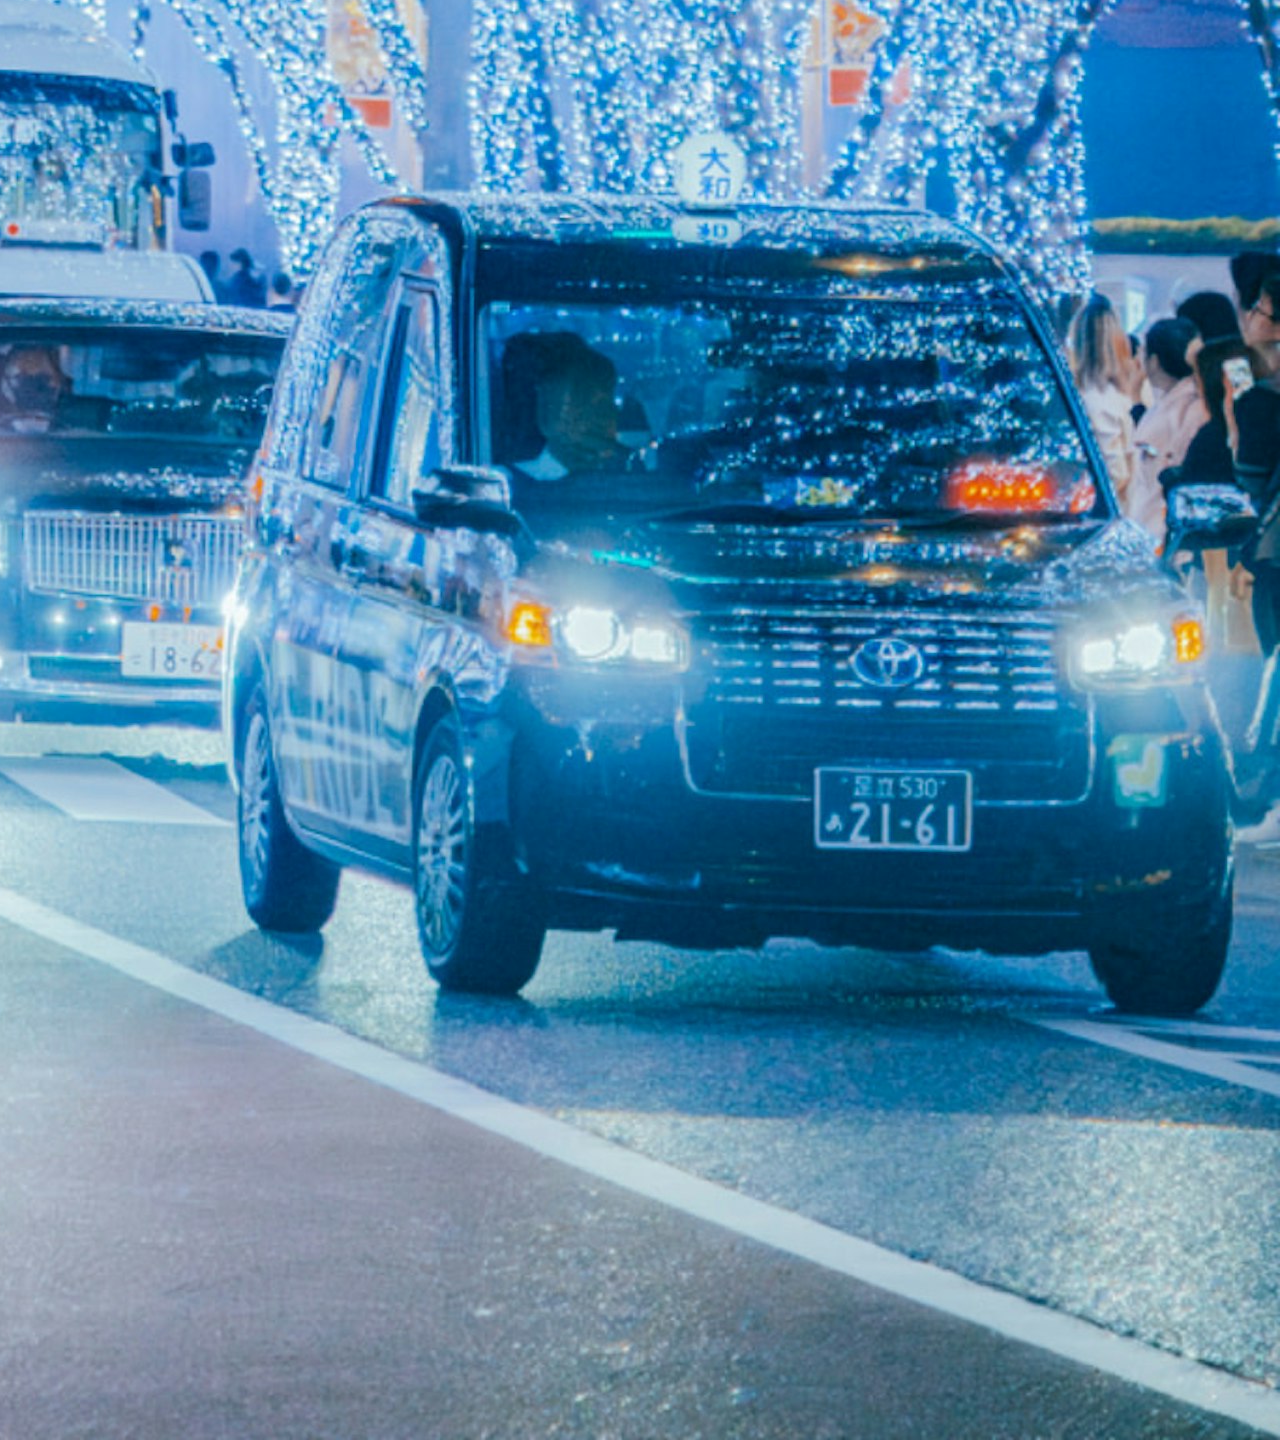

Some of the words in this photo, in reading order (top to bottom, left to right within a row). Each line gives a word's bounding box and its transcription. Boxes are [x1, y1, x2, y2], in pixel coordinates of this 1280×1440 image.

[697, 145, 733, 200] 大和
[899, 776, 939, 799] 530
[849, 802, 955, 846] 21-61
